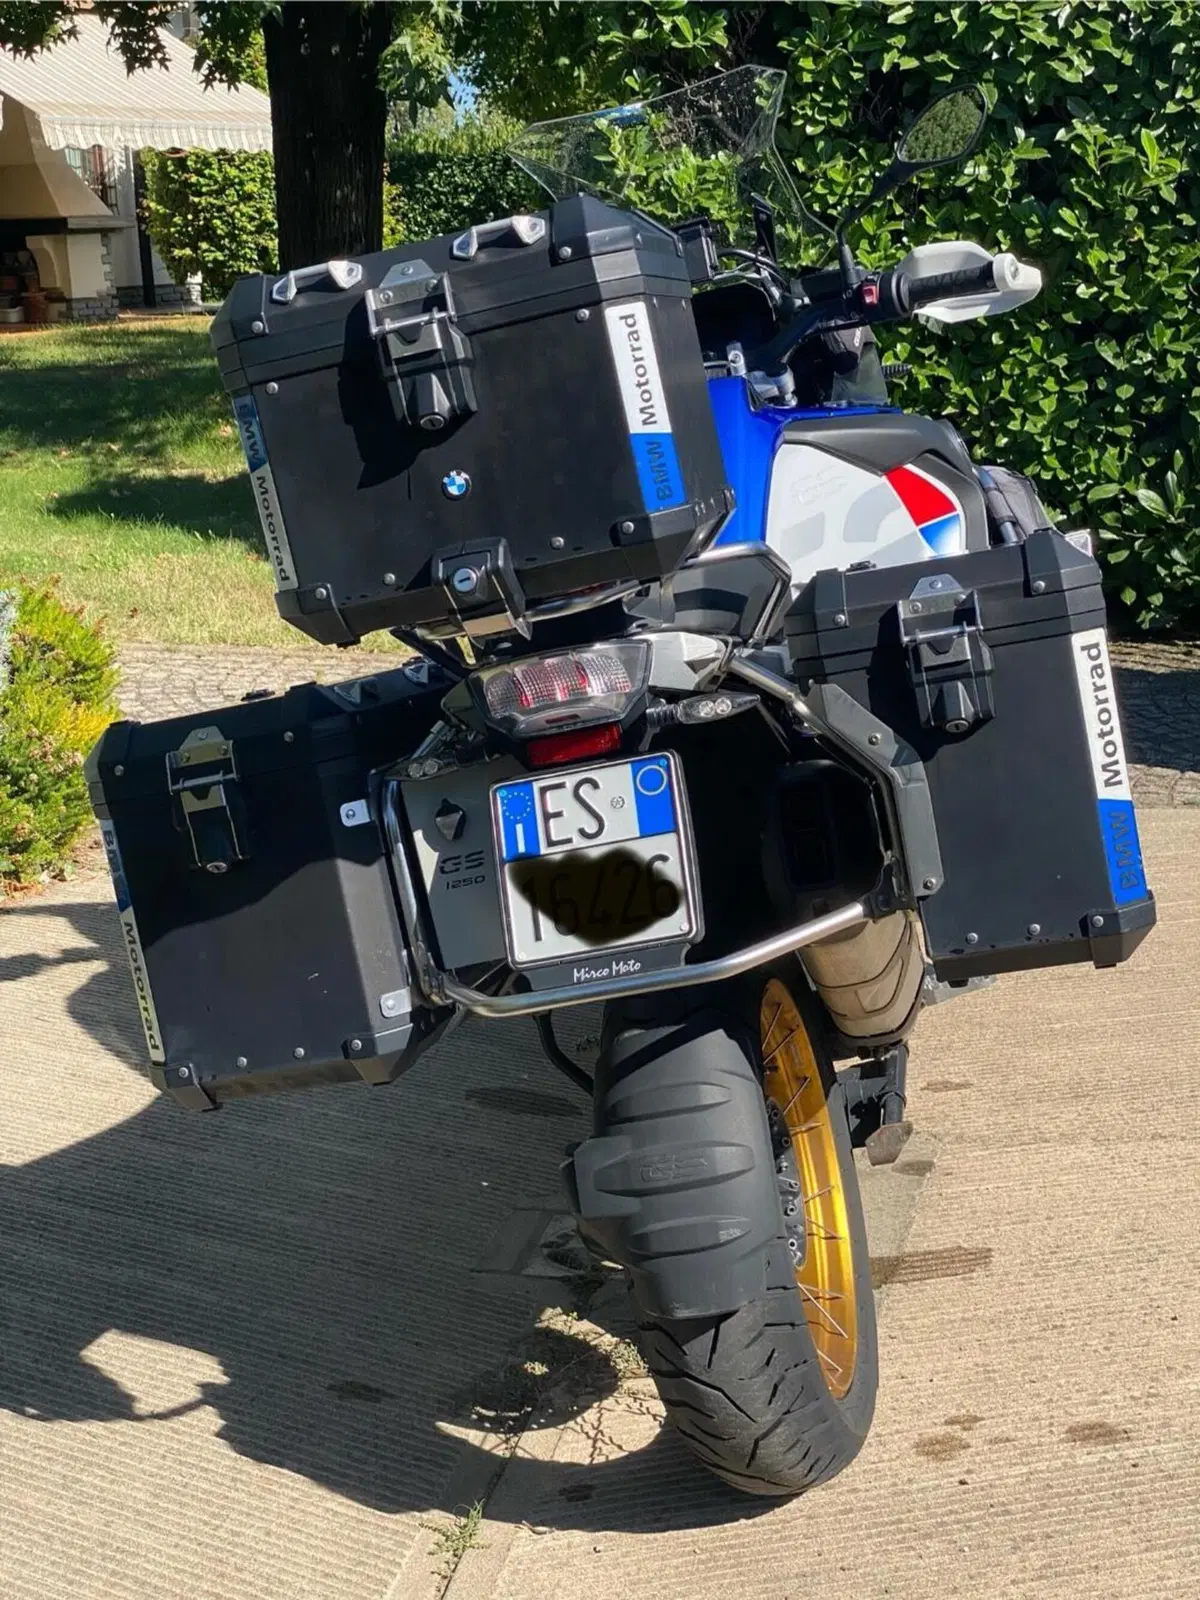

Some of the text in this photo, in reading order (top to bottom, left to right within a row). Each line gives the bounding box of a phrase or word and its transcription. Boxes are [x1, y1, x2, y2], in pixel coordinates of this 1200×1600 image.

[619, 312, 673, 501] BMW Motorrad
[256, 475, 290, 582] Motorrad
[1080, 641, 1140, 890] BMW Motorrad
[539, 777, 606, 848] ES
[439, 850, 486, 875] GS
[446, 875, 486, 890] 1250
[124, 921, 161, 1051] Motorrad
[573, 959, 641, 983] Mirco Moto
